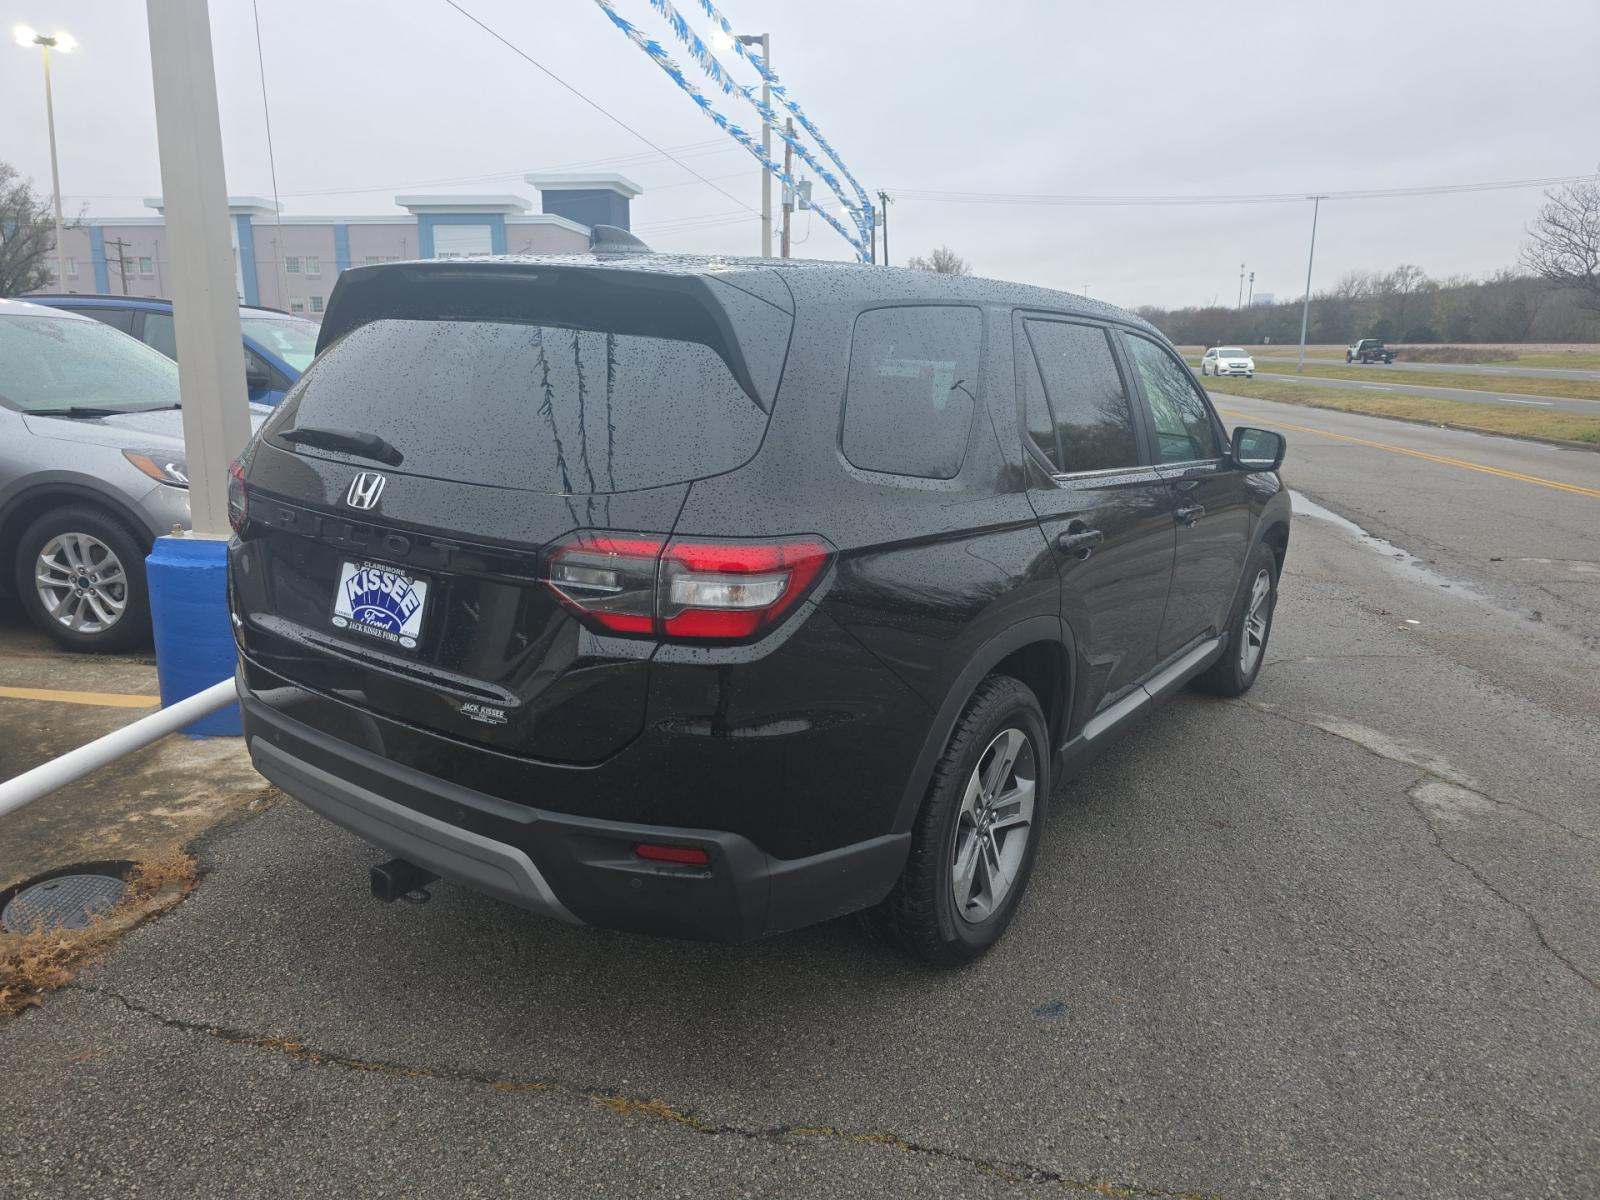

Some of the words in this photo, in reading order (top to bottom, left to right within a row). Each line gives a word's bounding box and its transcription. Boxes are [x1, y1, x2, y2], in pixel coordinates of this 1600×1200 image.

[363, 561, 406, 576] CLAREMORE
[346, 568, 420, 618] KISSEE
[361, 609, 393, 630] Ford
[349, 621, 364, 633] JACK
[363, 625, 382, 638] KISSEE
[382, 630, 399, 642] FORD
[463, 702, 479, 712] JACK
[480, 706, 506, 718] KISSEE
